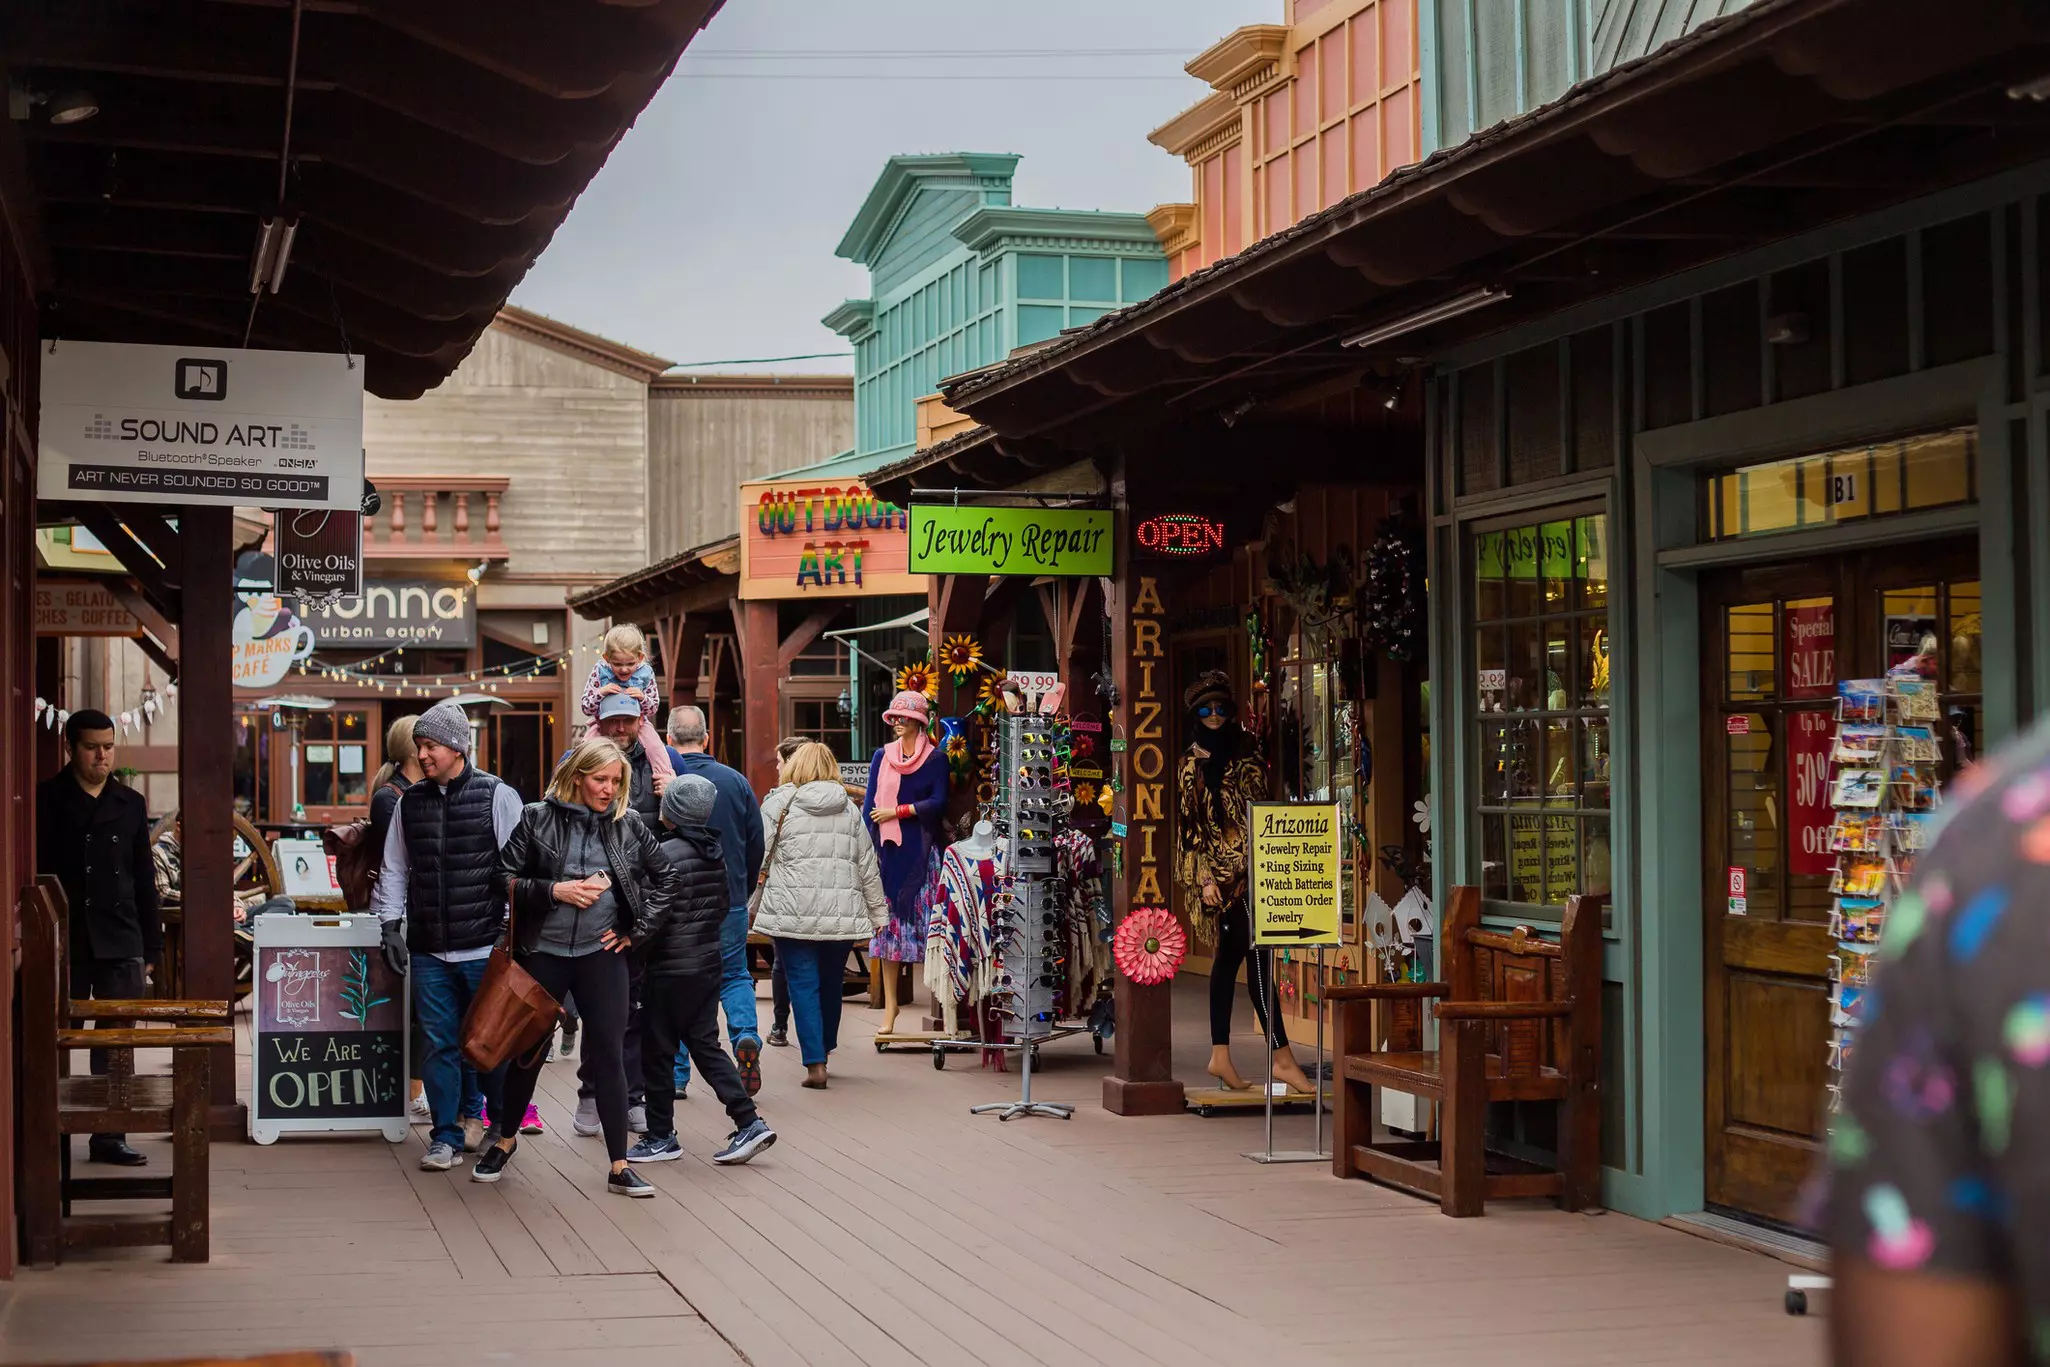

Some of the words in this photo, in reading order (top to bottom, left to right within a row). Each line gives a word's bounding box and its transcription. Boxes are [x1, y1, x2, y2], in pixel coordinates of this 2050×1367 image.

[120, 418, 219, 445] SOUND
[225, 424, 283, 448] ART
[208, 454, 262, 468] Speaker
[75, 470, 105, 482] ART
[110, 472, 159, 485] NEVER
[163, 474, 236, 489] SOUNDED
[241, 478, 262, 490] SO
[918, 517, 1013, 568] Jewelry
[1021, 518, 1105, 567] Repair
[1137, 520, 1224, 548] OPEN
[282, 553, 321, 569] Olive
[325, 554, 355, 570] Oils
[796, 539, 870, 587] ART
[291, 570, 302, 581] &
[303, 570, 346, 584] Vinegars
[66, 591, 115, 607] GELATO
[82, 609, 131, 625] COFFEE
[321, 626, 373, 638] urban
[386, 626, 443, 640] eatery
[1790, 614, 1834, 645] Special
[1791, 650, 1835, 688] SALE
[1800, 713, 1812, 737] Up
[1813, 713, 1827, 731] To
[1132, 576, 1165, 903] ARIZONIA
[1259, 812, 1329, 837] Arizonia
[1265, 842, 1300, 857] Jewelry
[1302, 842, 1332, 857] Repair
[1266, 861, 1290, 874] Ring
[1293, 860, 1324, 874] Sizing
[1265, 878, 1293, 890] Watch
[1295, 878, 1333, 890] Batteries
[1266, 894, 1303, 907] Custom
[1305, 894, 1333, 906] Order
[1266, 911, 1304, 925] Jewelry
[281, 1001, 300, 1009] Olive
[323, 1038, 361, 1062] ARE
[269, 1067, 378, 1108] OPEN
